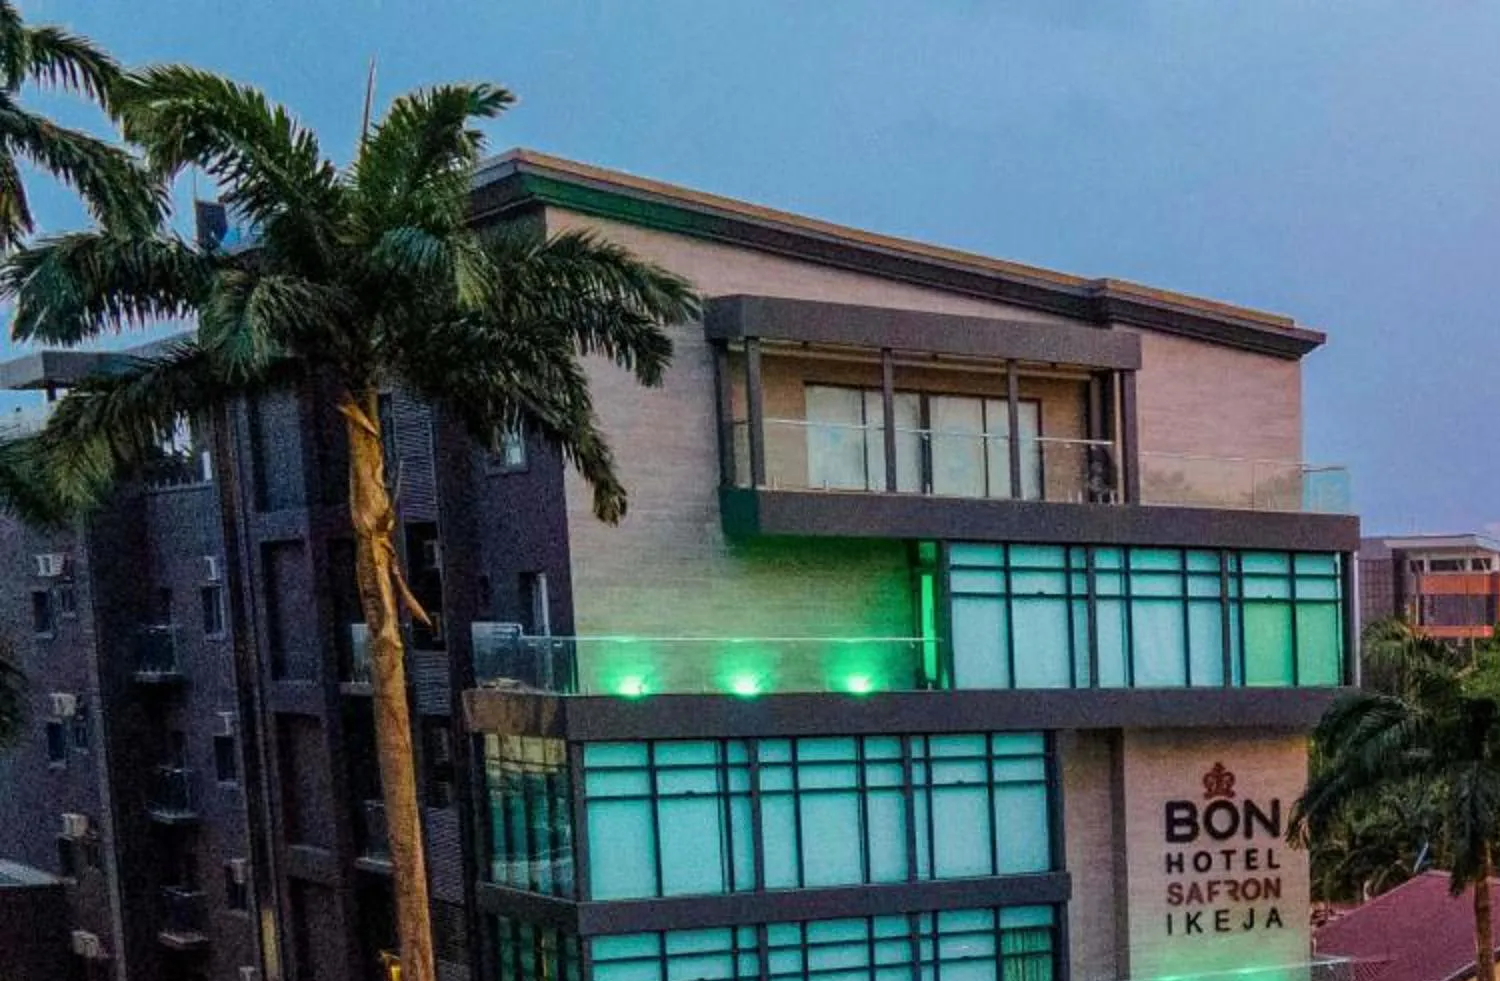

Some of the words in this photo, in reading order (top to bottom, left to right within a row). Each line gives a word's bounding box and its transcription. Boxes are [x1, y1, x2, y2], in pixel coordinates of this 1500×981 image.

[1164, 798, 1281, 844] BON
[1165, 848, 1281, 874] HOTEL
[1166, 877, 1282, 907] SAFRON
[1166, 907, 1283, 936] IKEJA
